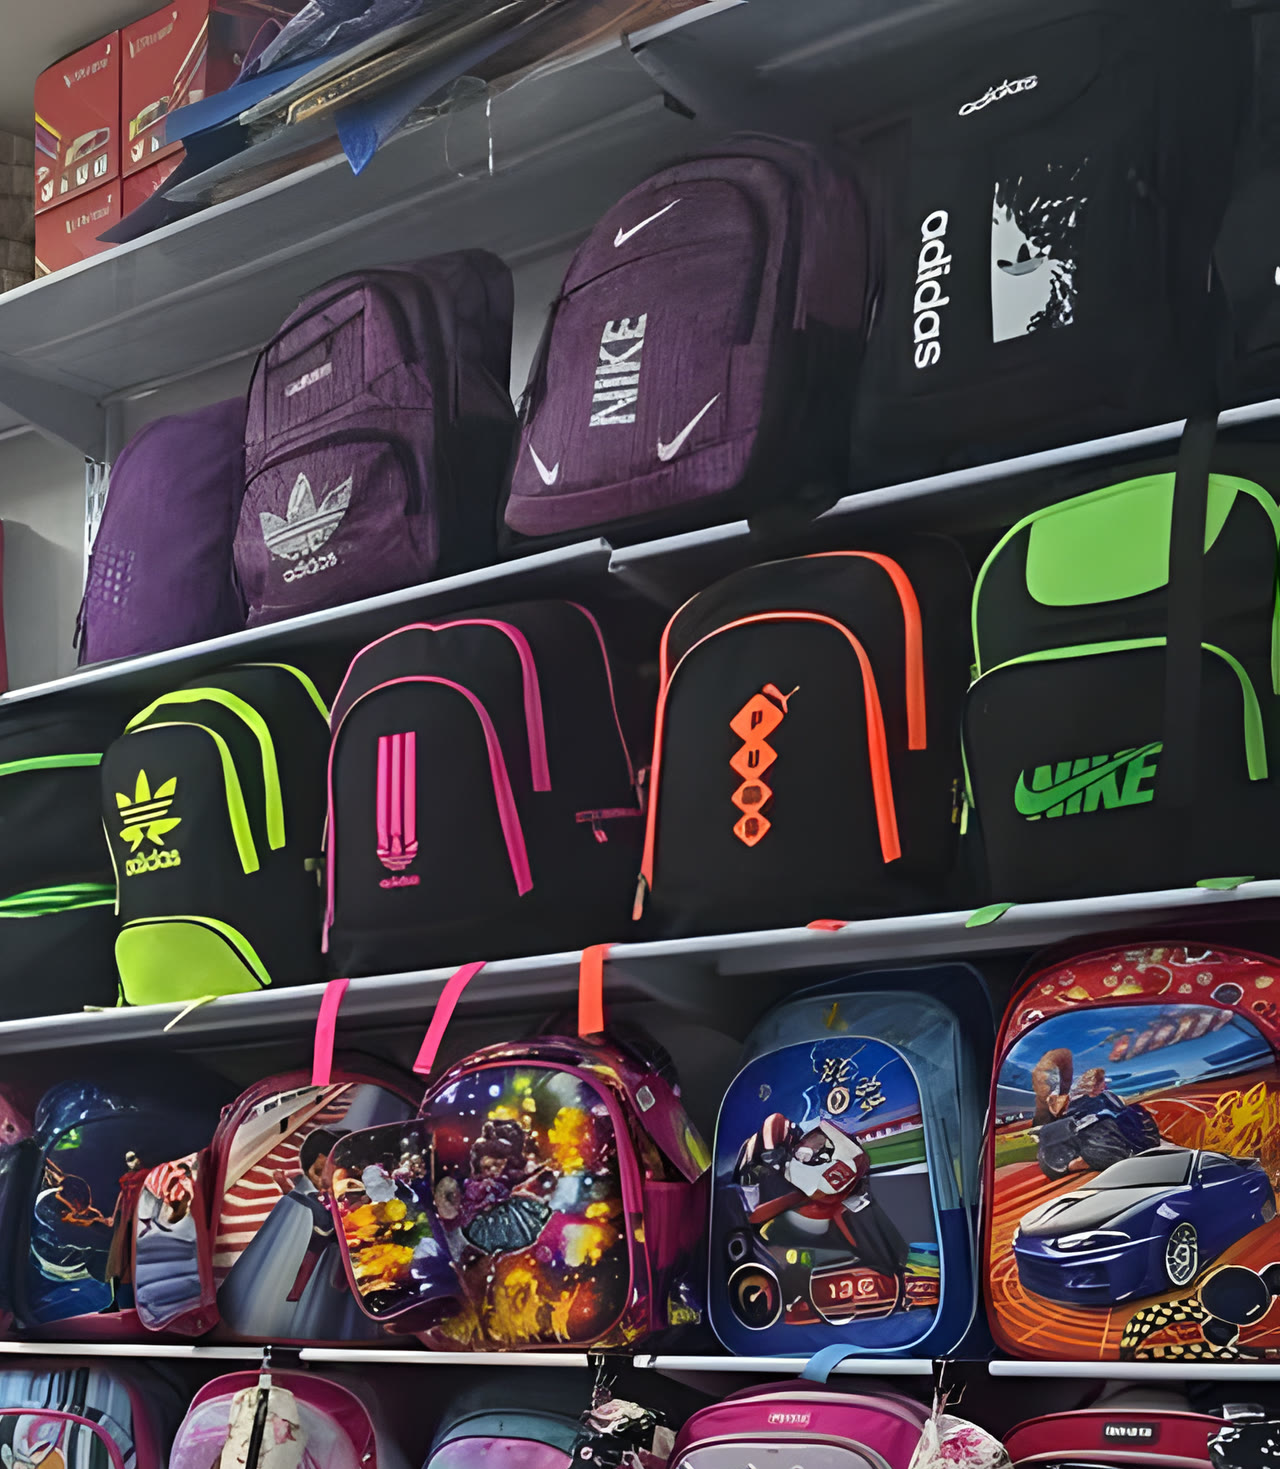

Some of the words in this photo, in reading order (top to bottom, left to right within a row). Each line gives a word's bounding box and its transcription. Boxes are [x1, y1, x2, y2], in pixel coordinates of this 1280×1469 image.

[914, 209, 953, 369] adidas
[589, 313, 648, 427] NIKE
[1024, 745, 1159, 821] NIKE
